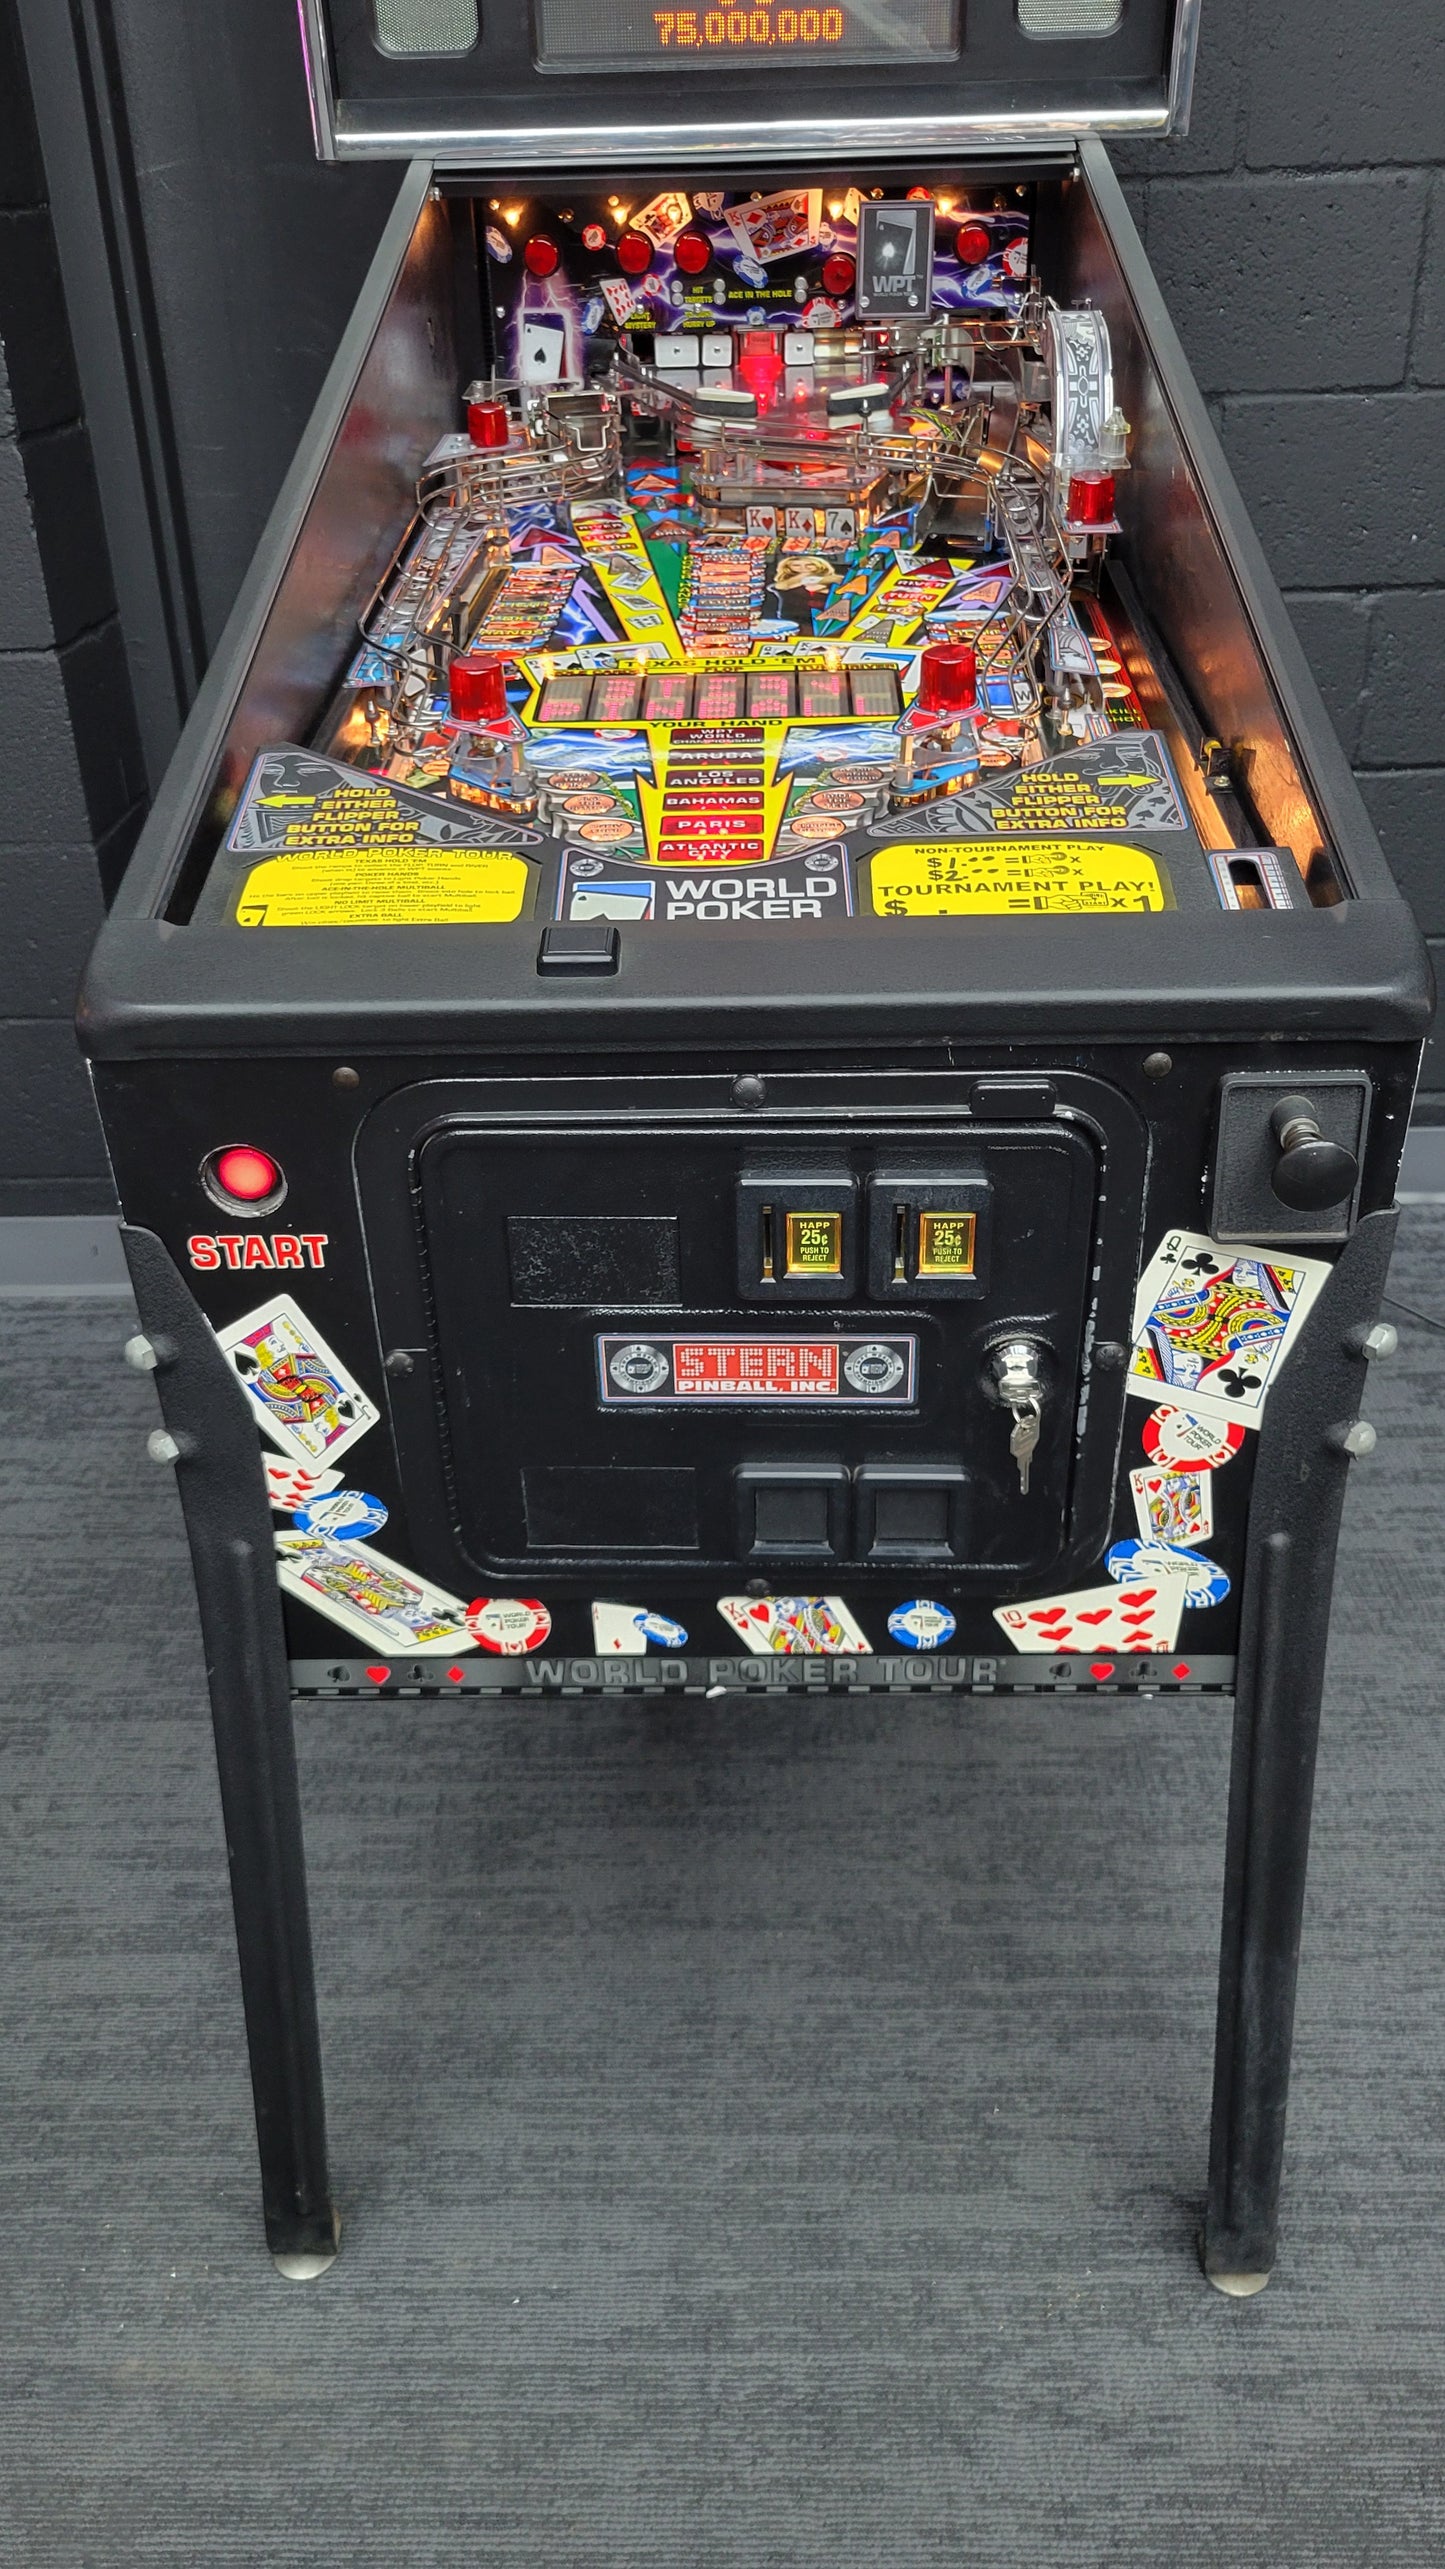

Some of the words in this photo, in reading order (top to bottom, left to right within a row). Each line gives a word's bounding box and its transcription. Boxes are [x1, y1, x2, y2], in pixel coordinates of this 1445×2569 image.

[653, 9, 843, 49] 75,000,000
[872, 275, 916, 293] WPT
[728, 290, 744, 299] ACE
[745, 290, 754, 298] IN
[756, 290, 771, 298] THE
[774, 289, 792, 298] HOLE
[749, 509, 760, 528] K
[789, 509, 800, 528] K
[828, 511, 838, 531] 7
[897, 579, 947, 589] RIVER
[888, 592, 936, 602] TURN
[624, 660, 697, 669] TXAS
[705, 657, 766, 667] HOLD
[774, 656, 816, 666] 'EM
[650, 720, 706, 728] YOUR
[720, 719, 782, 727] HAND
[681, 751, 752, 760] ARUBA
[697, 770, 734, 778] LOS
[1022, 773, 1080, 783] HOLD
[670, 777, 760, 786] ANGELES
[334, 788, 391, 798] HOLD
[1015, 783, 1092, 794] EITHER
[321, 799, 396, 810] EITHER
[666, 796, 760, 805] BAHAMAS
[1011, 795, 1102, 805] FLIPPER
[312, 811, 399, 822] FLIPPER
[992, 807, 1077, 818] BUTTON
[1084, 806, 1127, 816] FOR
[286, 823, 371, 834] BUTTON
[378, 822, 419, 831] FOR
[677, 819, 746, 828] PARIS
[996, 819, 1065, 830] EXTRA
[1075, 818, 1128, 828] INFO
[285, 834, 356, 846] EXTRA
[362, 833, 414, 843] INFO
[662, 842, 759, 851] ATLANTIC
[914, 844, 1062, 855] NON-TOURNAMENT
[1067, 844, 1105, 852] PLAY
[276, 849, 358, 862] WORLD
[367, 848, 443, 858] POKER
[453, 849, 514, 860] TOUR
[687, 849, 732, 857] CITY
[666, 877, 837, 900] WORLD
[878, 881, 1068, 897] TOURNAMENT
[1080, 881, 1156, 892] PLAY!
[667, 899, 822, 920] POKER
[800, 1221, 830, 1229] HAPP
[933, 1222, 964, 1230] HAPP
[801, 1229, 828, 1248] 25¢
[934, 1230, 962, 1248] 25¢
[1166, 1236, 1182, 1252] Q
[187, 1233, 329, 1270] START
[933, 1247, 952, 1255] PUSH
[953, 1247, 962, 1255] TO
[802, 1254, 827, 1262] REJECT
[935, 1255, 960, 1263] REJECT
[680, 1347, 832, 1377] STERN
[678, 1380, 783, 1393] PINBALL,
[790, 1379, 836, 1393] INC.
[1190, 1430, 1212, 1448] POKER
[1197, 1426, 1221, 1445] WORLD
[1184, 1435, 1204, 1450] TOUR
[1133, 1474, 1143, 1486] K
[724, 1602, 744, 1620] K
[1001, 1609, 1023, 1624] 10
[526, 1659, 688, 1685] WORLD
[709, 1658, 858, 1684] POKER
[878, 1657, 998, 1684] TOUR
